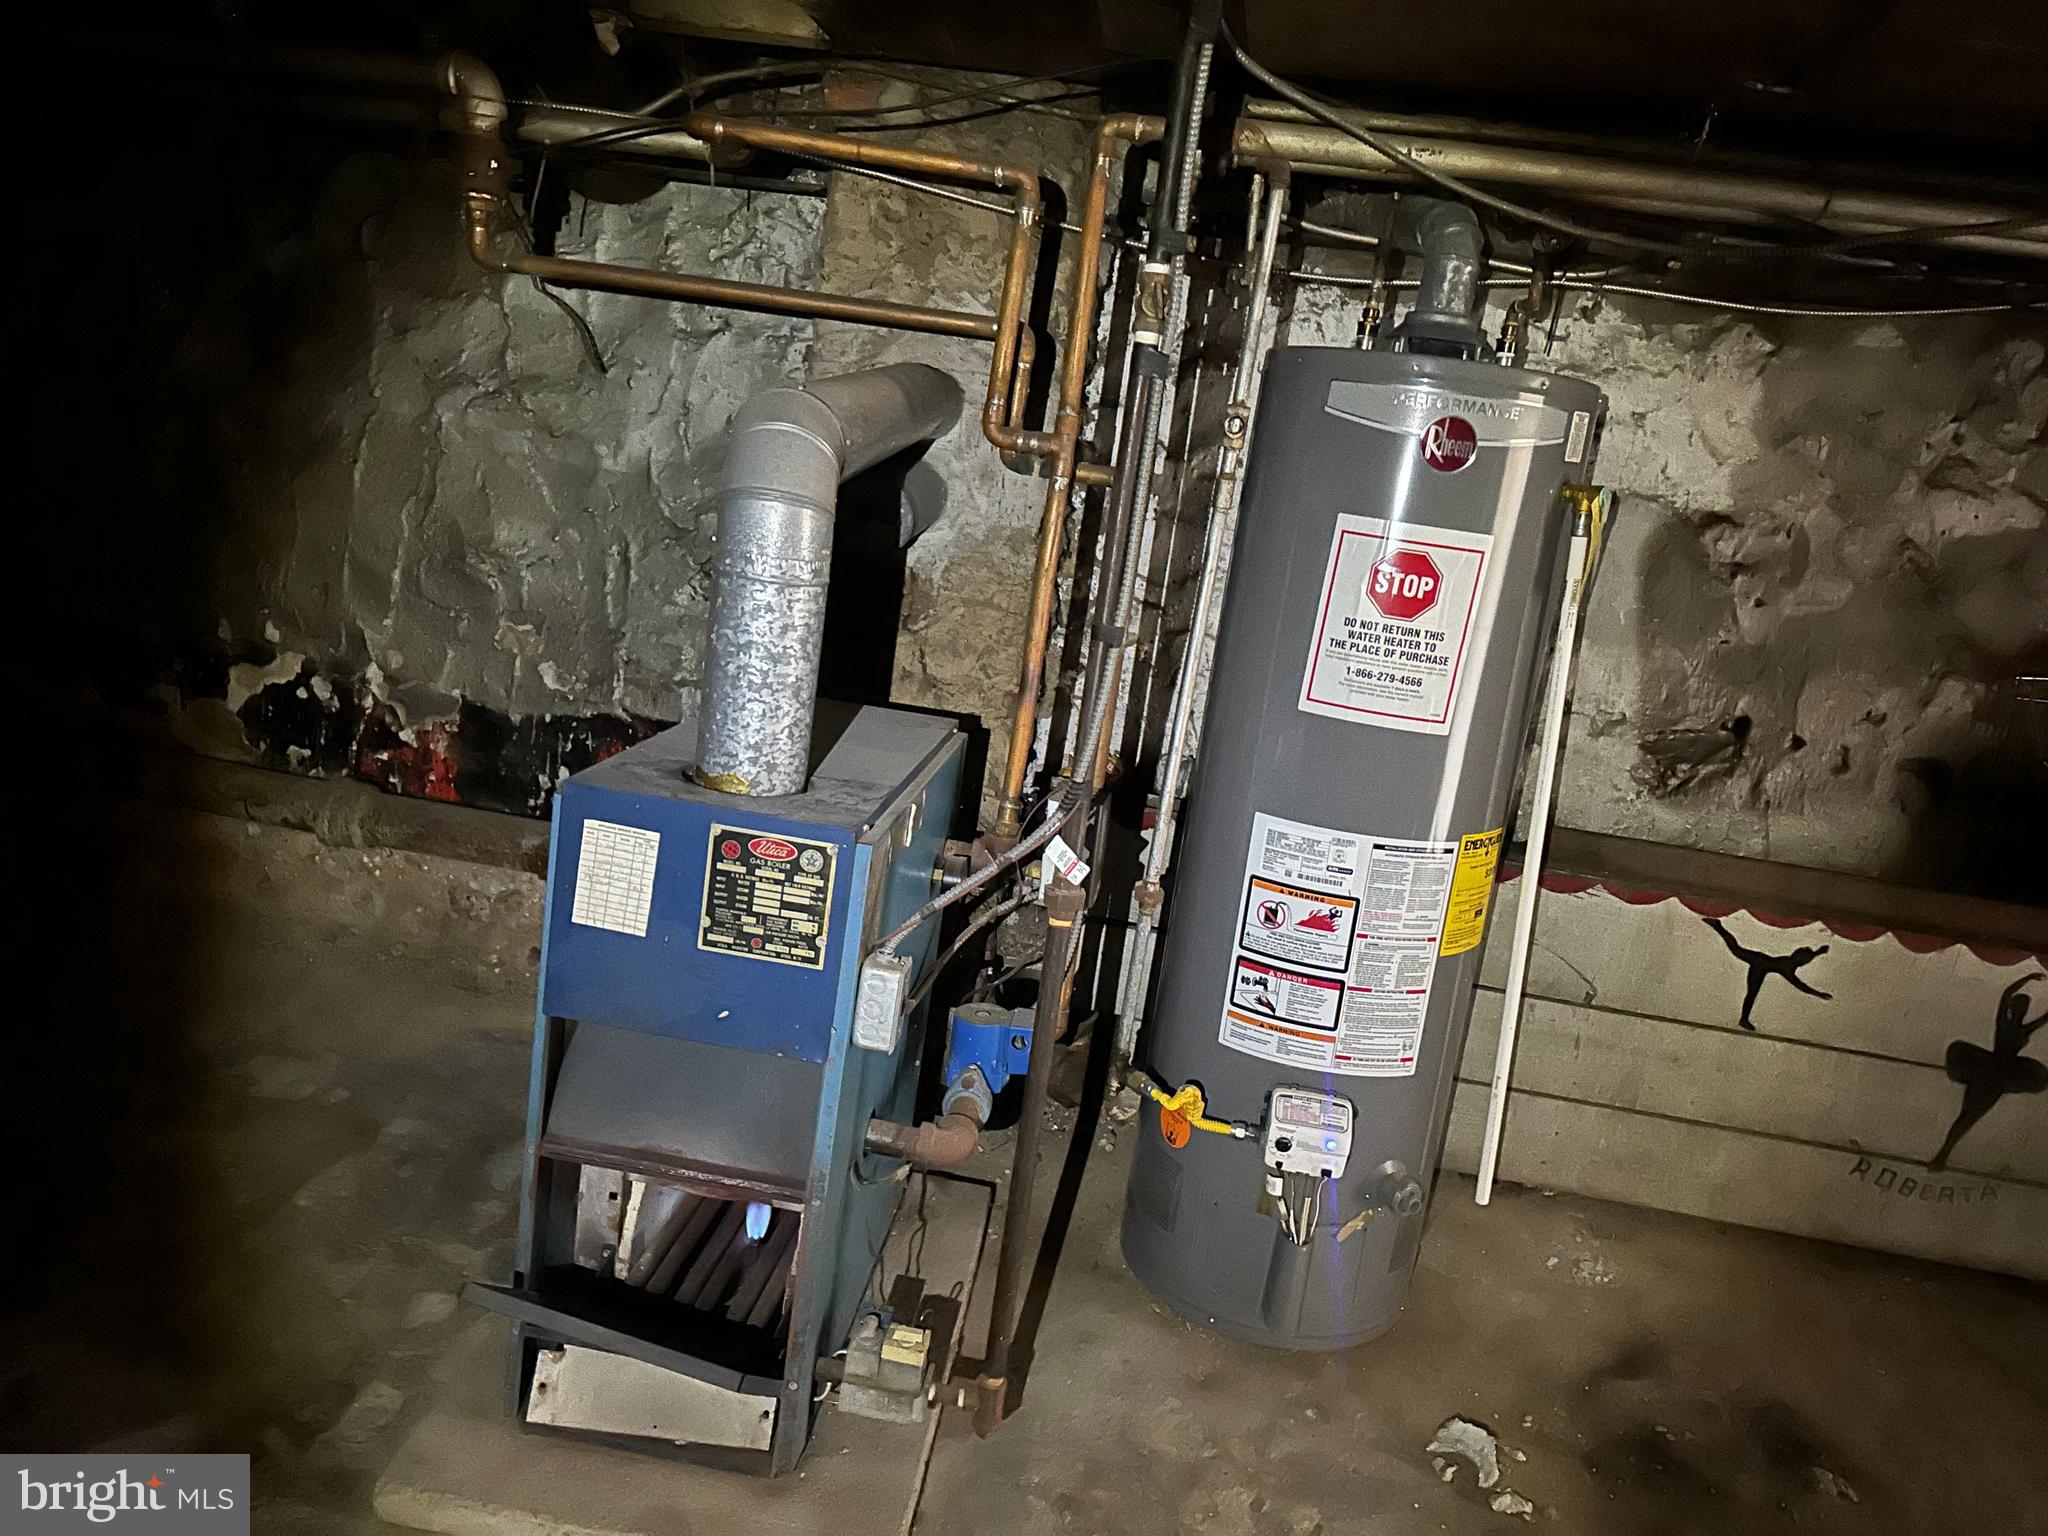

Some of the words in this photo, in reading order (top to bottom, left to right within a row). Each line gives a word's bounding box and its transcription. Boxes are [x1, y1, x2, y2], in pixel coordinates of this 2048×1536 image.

[1392, 391, 1521, 420] PERFORMANCE
[1425, 417, 1474, 463] Rheem
[1374, 571, 1435, 600] STOP
[1343, 616, 1358, 628] DO
[1359, 619, 1380, 632] NOT
[1381, 623, 1421, 638] RETURN
[1424, 629, 1446, 642] THIS
[1329, 637, 1347, 650] THE
[1350, 641, 1382, 656] PLACE
[1383, 647, 1397, 659] OF
[1399, 650, 1450, 667] PURCHASE
[1348, 629, 1382, 644] WATER
[1383, 635, 1421, 650] HEATER
[1424, 640, 1437, 653] TO
[1345, 665, 1423, 688] 1-866-279-4566
[757, 840, 791, 857] Utica
[750, 857, 766, 866] GAS
[767, 860, 791, 870] BOILER
[1287, 890, 1325, 903] WARNING
[1276, 972, 1309, 984] DANGER
[1270, 1024, 1300, 1037] WARNING
